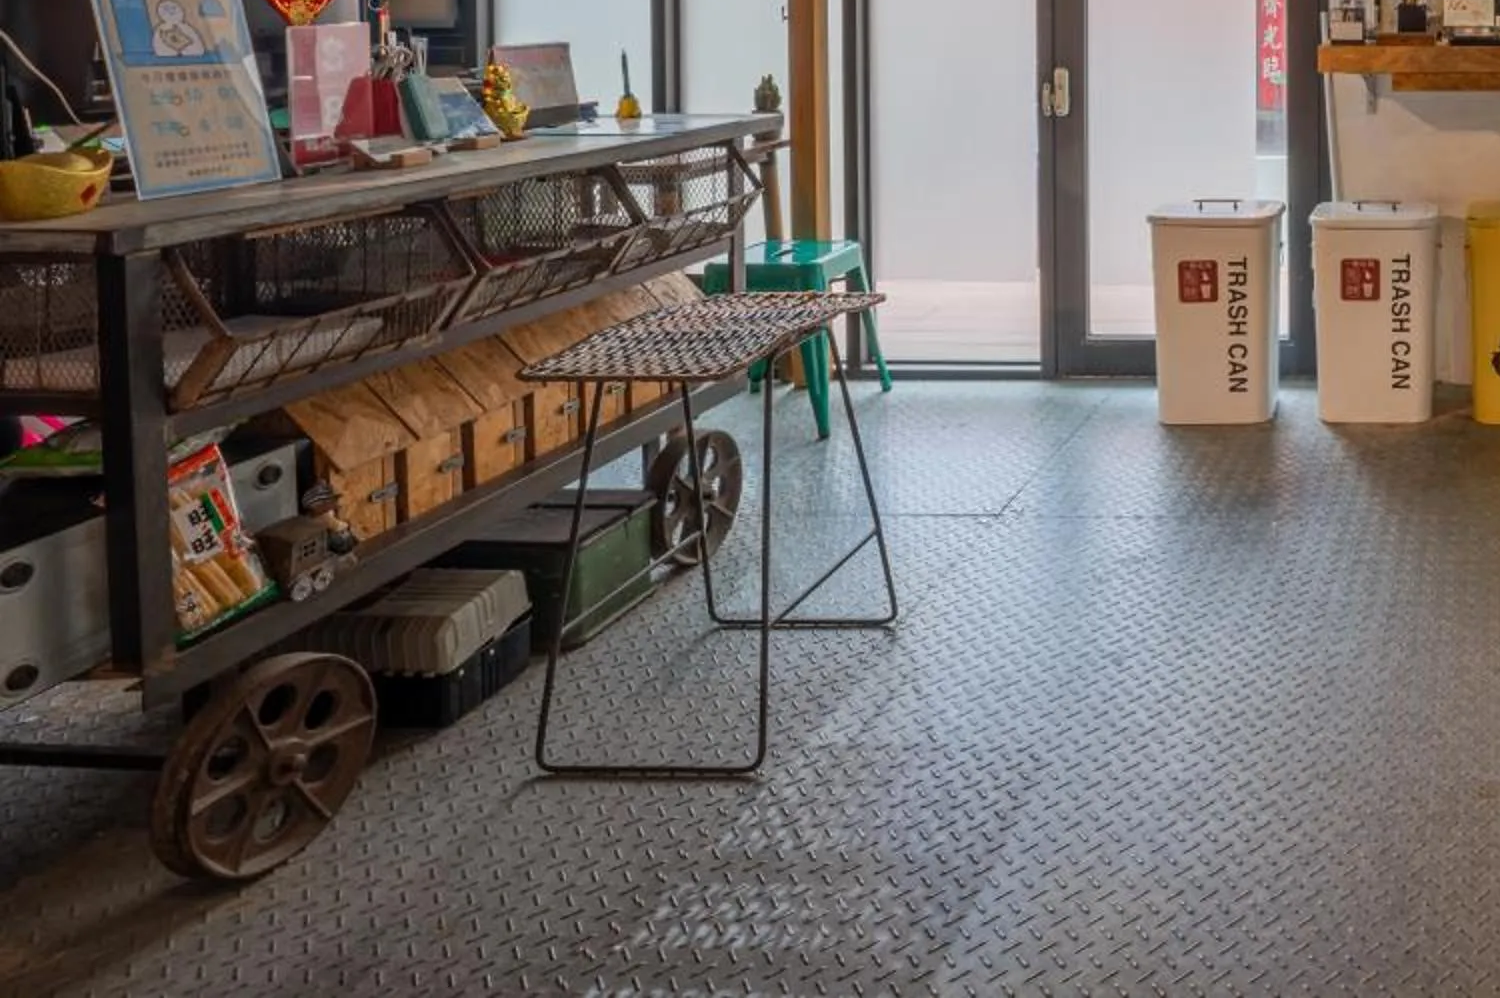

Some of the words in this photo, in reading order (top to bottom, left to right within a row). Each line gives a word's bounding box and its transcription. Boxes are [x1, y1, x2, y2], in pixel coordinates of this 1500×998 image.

[1227, 256, 1248, 336] TRASH
[1391, 253, 1411, 333] TRASH
[1227, 344, 1249, 393] CAN
[1391, 341, 1411, 389] CAN
